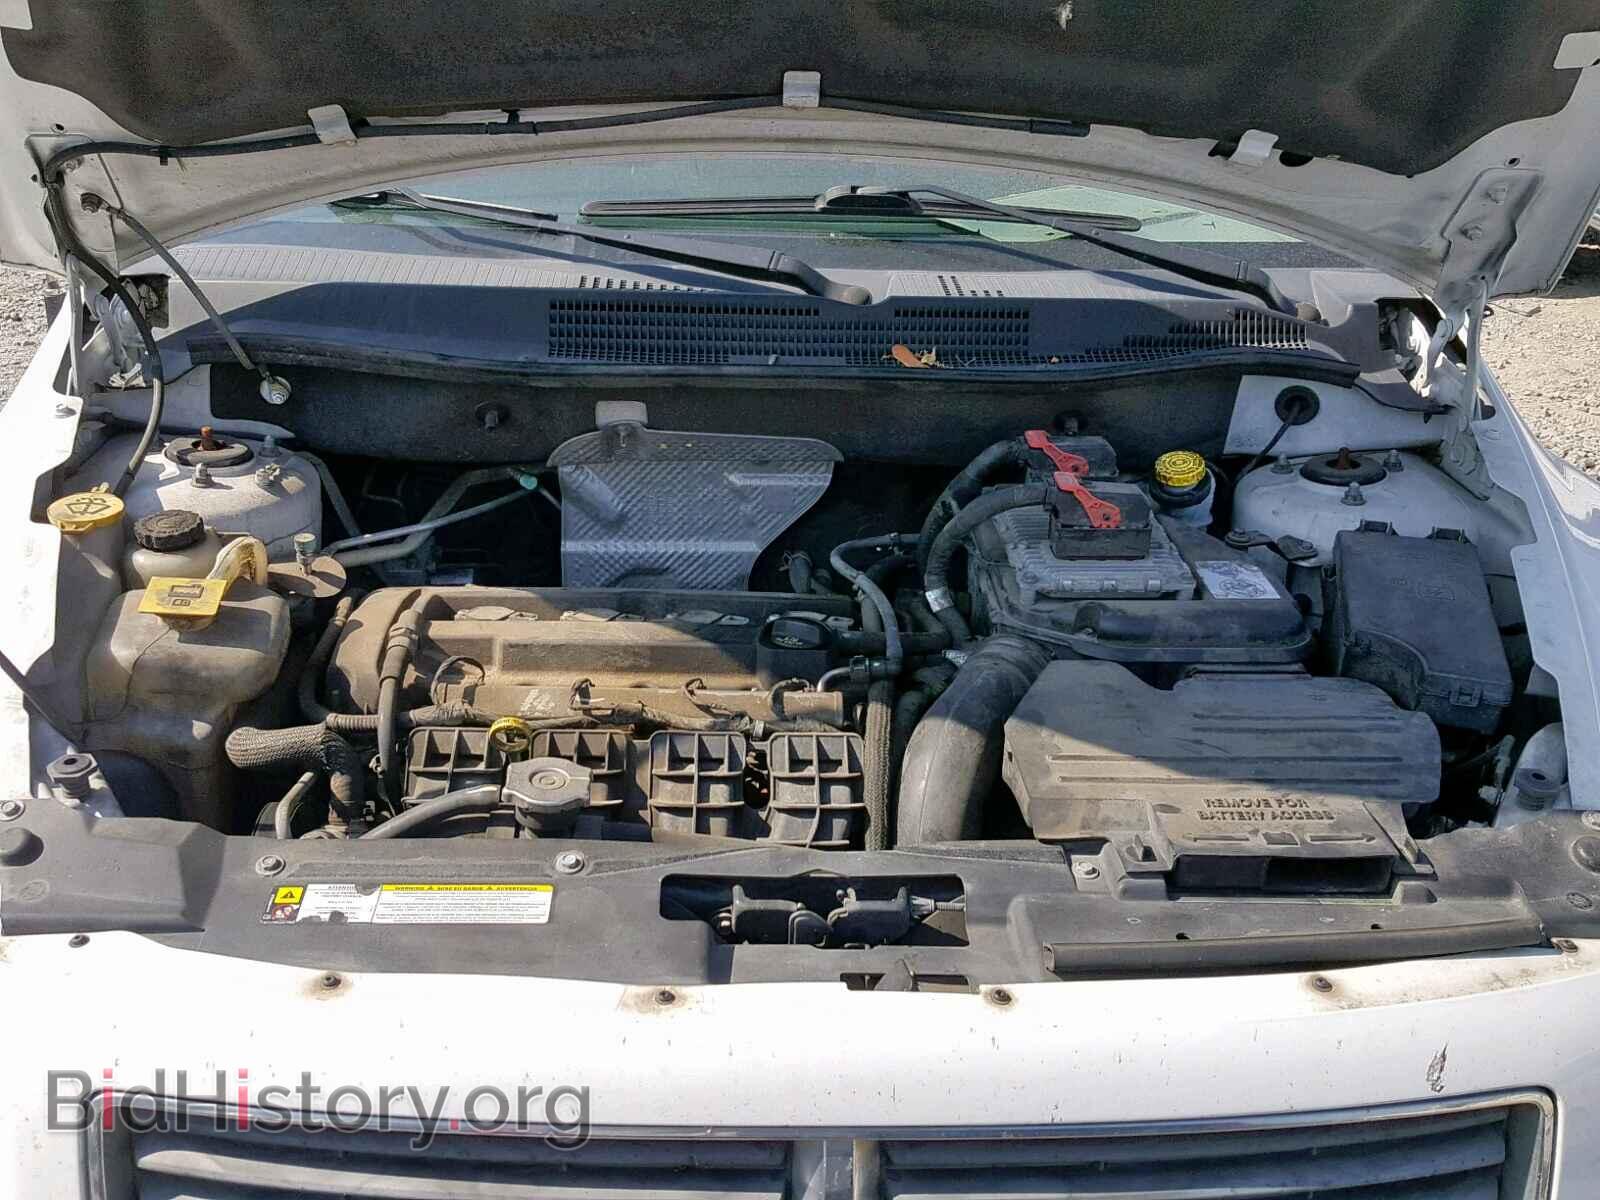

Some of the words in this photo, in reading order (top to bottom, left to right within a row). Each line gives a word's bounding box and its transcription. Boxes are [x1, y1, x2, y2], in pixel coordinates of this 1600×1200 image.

[1203, 798, 1272, 809] REMOVE
[1276, 798, 1310, 809] FOR
[1197, 810, 1264, 821] BATTERY
[1271, 810, 1335, 821] ACCESS
